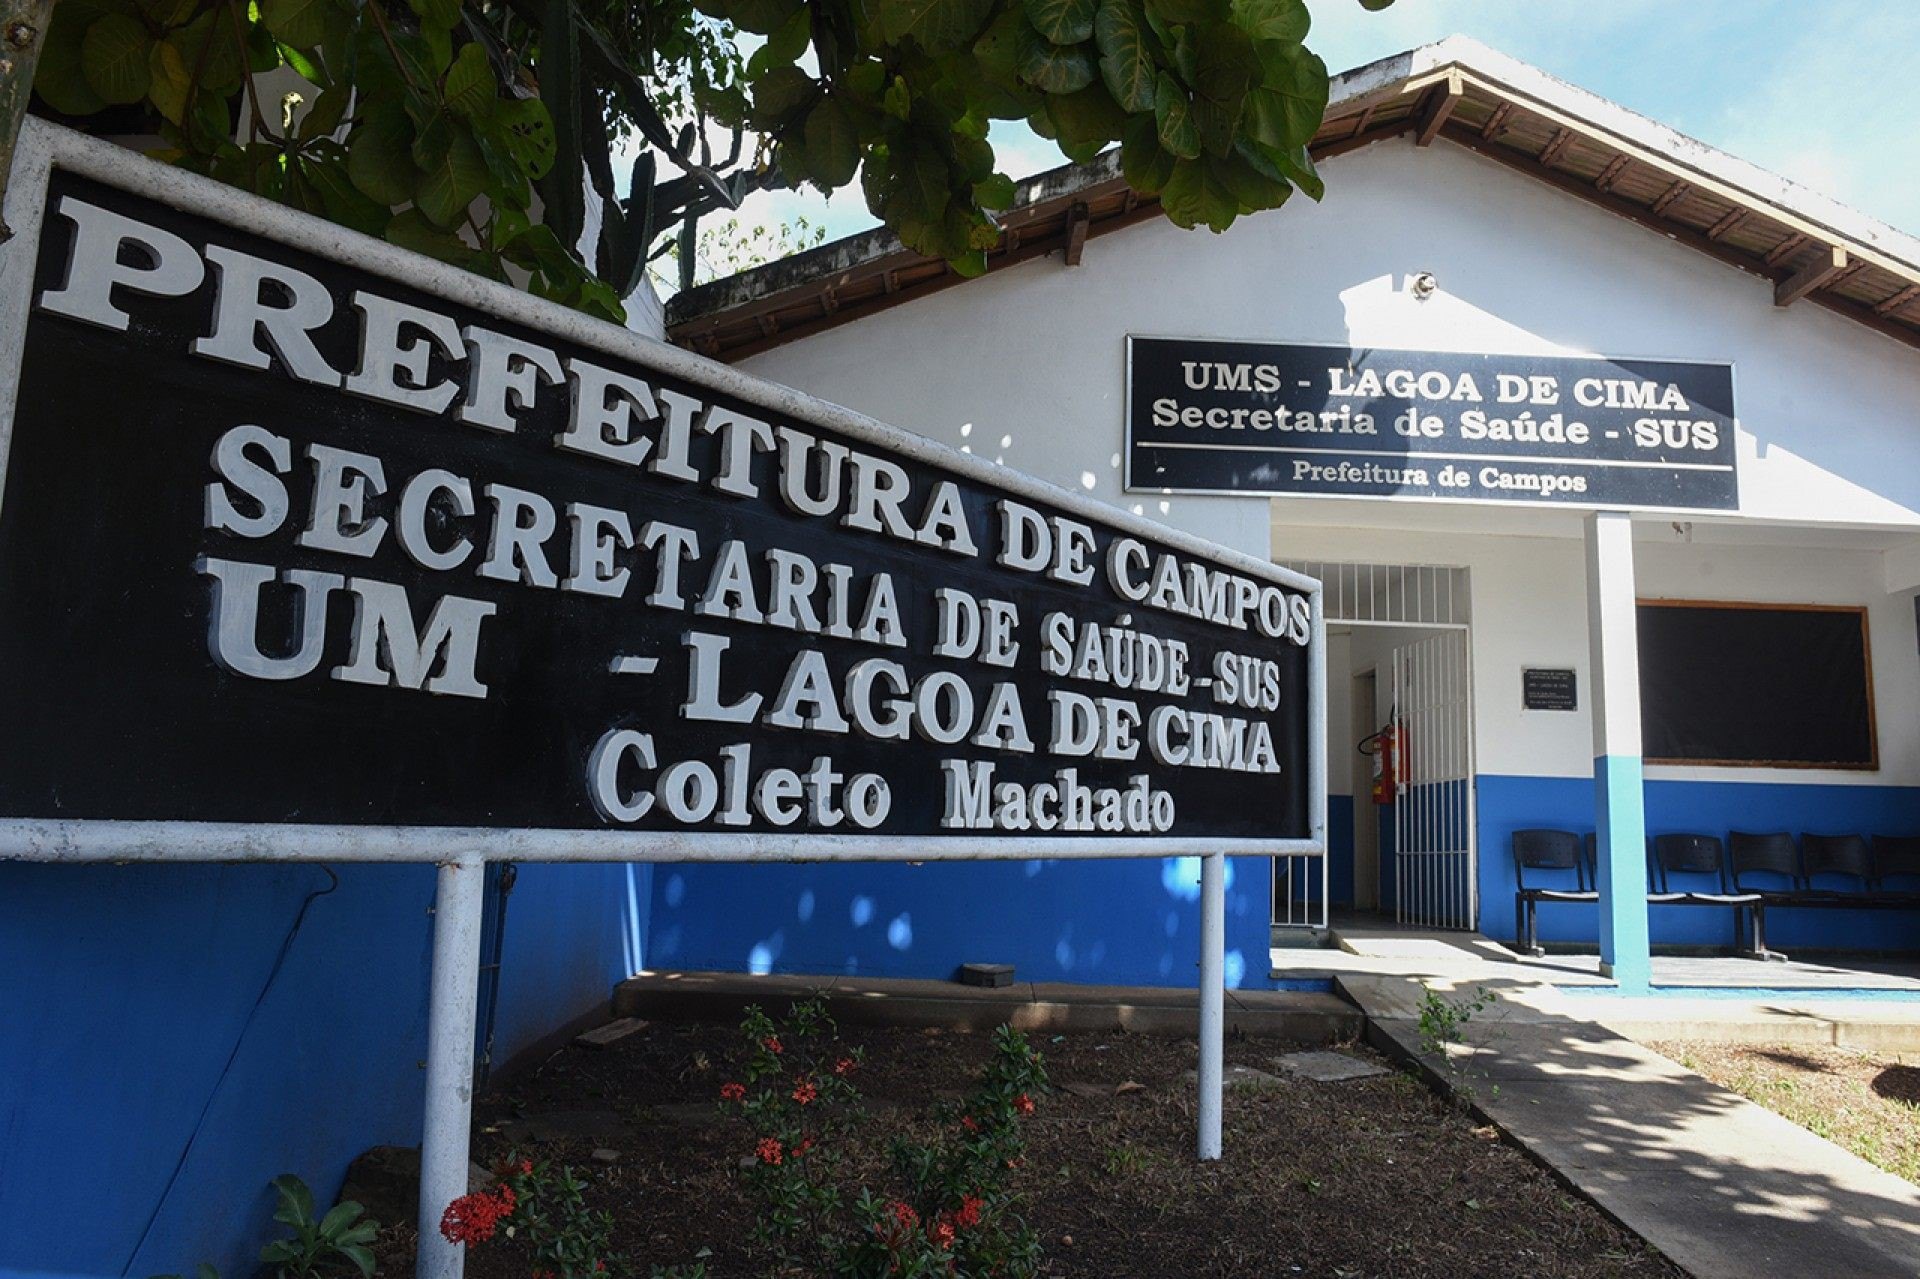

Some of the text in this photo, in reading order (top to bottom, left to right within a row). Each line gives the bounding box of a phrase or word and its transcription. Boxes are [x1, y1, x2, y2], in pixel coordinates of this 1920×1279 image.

[37, 194, 1311, 647] PREFEITURA DE CAMPOS
[1152, 398, 1377, 434] Secretaria
[1394, 407, 1443, 438] de
[1460, 410, 1590, 444] Saúde
[1634, 418, 1719, 450] SUS
[1181, 361, 1282, 393] UMS
[1328, 367, 1483, 401] LAGOA
[1496, 374, 1560, 405] DE
[1573, 378, 1690, 412] CIMA
[1292, 460, 1588, 496] Prefeitura de Campos
[203, 424, 907, 648] SECRETARIA
[932, 588, 1021, 668] DE
[198, 556, 497, 699] UM
[1047, 689, 1142, 761] DE
[1149, 704, 1281, 774] CIMA
[585, 728, 1176, 833] Coleto Machado
